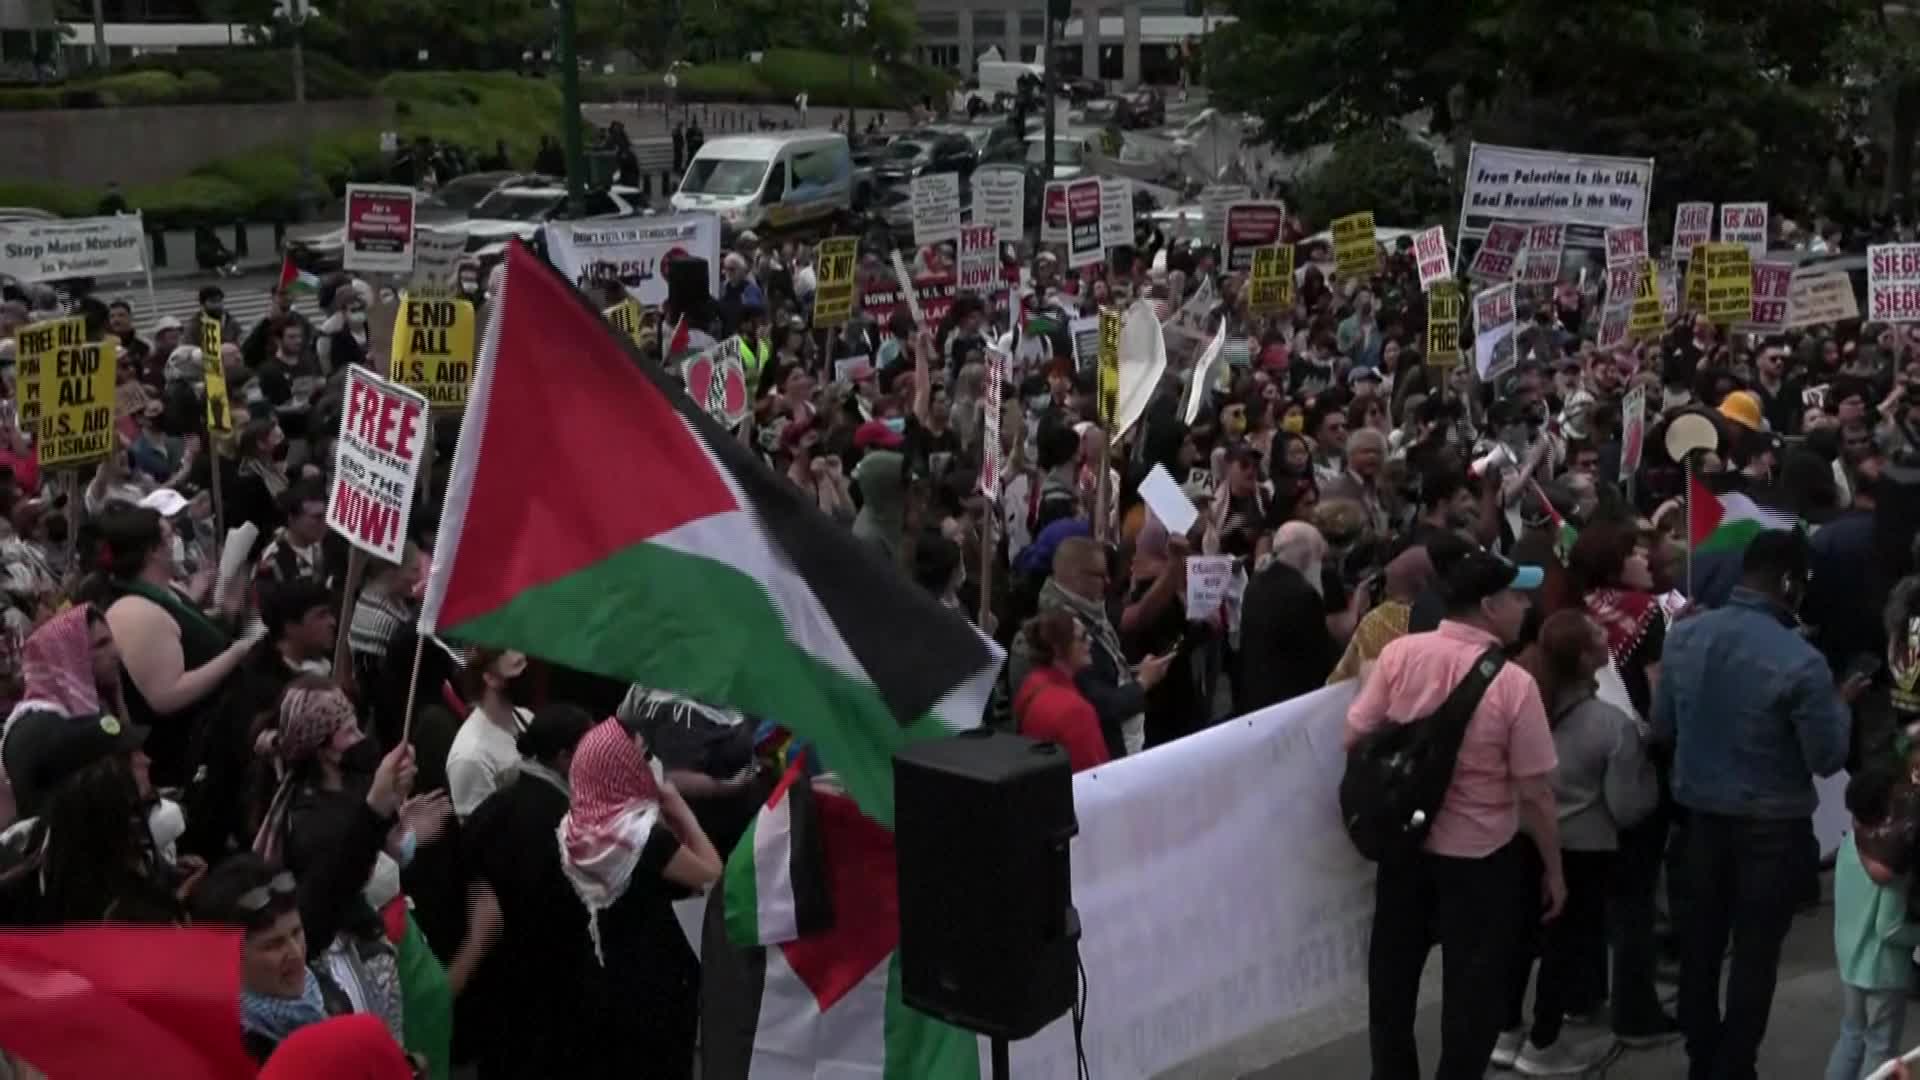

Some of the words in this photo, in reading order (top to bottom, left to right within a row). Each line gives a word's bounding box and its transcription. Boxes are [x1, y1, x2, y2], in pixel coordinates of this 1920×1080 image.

[1477, 168, 1510, 184] From
[1515, 168, 1570, 185] Palestine
[1591, 168, 1610, 184] the
[1472, 191, 1500, 208] Real
[1504, 191, 1569, 209] Revolution
[1586, 192, 1605, 208] the
[1609, 193, 1632, 211] Way
[1743, 211, 1764, 228] AID
[4, 242, 44, 259] Stop
[85, 236, 137, 252] Murder
[960, 227, 994, 251] FREE
[832, 255, 853, 281] NOT
[961, 266, 997, 285] NOW!
[1873, 255, 1920, 274] SIEGE
[864, 292, 894, 305] DOWN
[1874, 291, 1920, 313] SIEGE
[407, 301, 456, 328] END
[20, 329, 53, 356] FREE
[58, 323, 82, 346] ALL
[410, 329, 452, 355] ALL
[1431, 323, 1458, 352] FREE
[57, 348, 100, 377] END
[393, 360, 433, 384] U.S.
[436, 361, 468, 384] AID
[58, 377, 95, 408] ALL
[43, 412, 77, 439] U.S.
[83, 407, 110, 435] AID
[348, 378, 422, 462] FREE
[41, 443, 56, 461] TO
[57, 431, 110, 458] ISRAEL!
[340, 454, 367, 482] END
[369, 470, 407, 501] THE
[332, 478, 402, 554] NOW!
